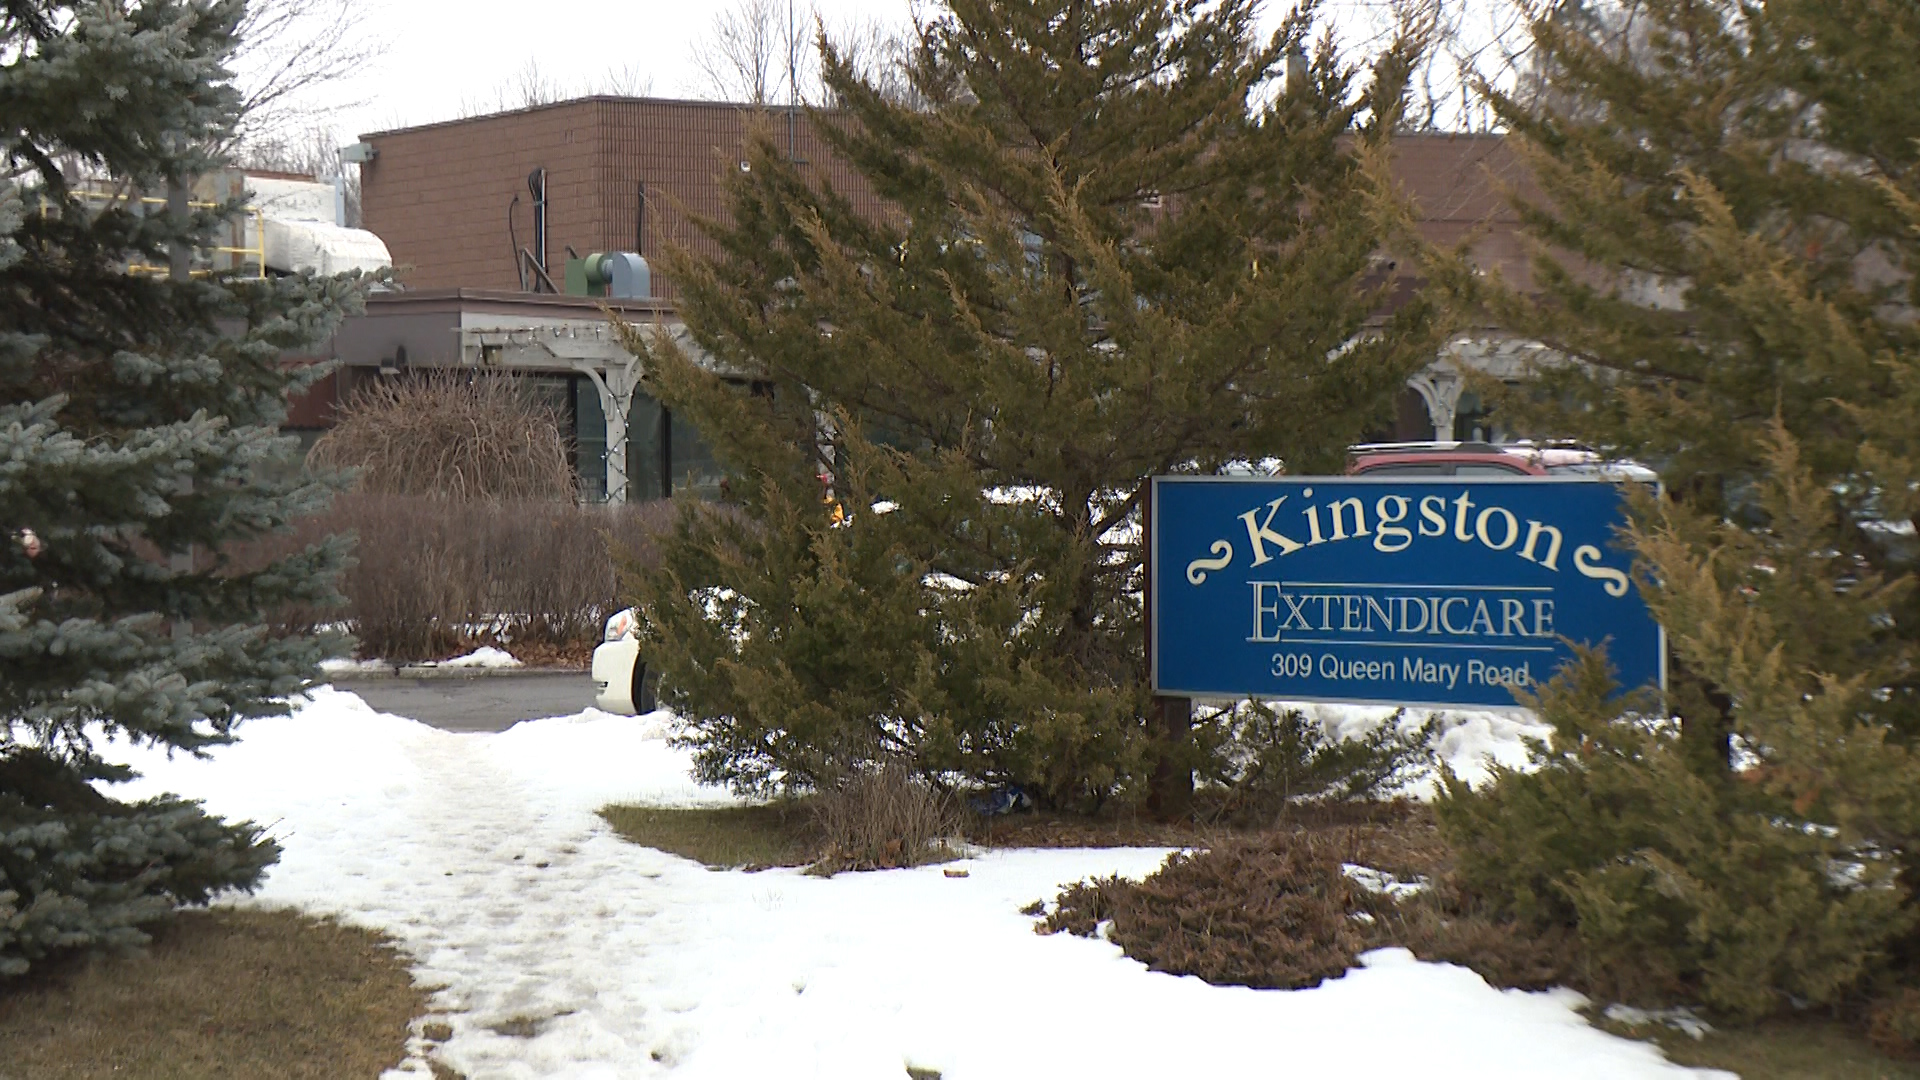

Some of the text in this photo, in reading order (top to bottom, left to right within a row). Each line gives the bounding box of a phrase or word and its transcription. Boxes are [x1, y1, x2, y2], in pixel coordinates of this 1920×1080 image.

[1237, 487, 1563, 572] Kingston
[1245, 581, 1555, 643] EXTENDICARE
[1271, 653, 1530, 690] 309 Queen Mary Road
